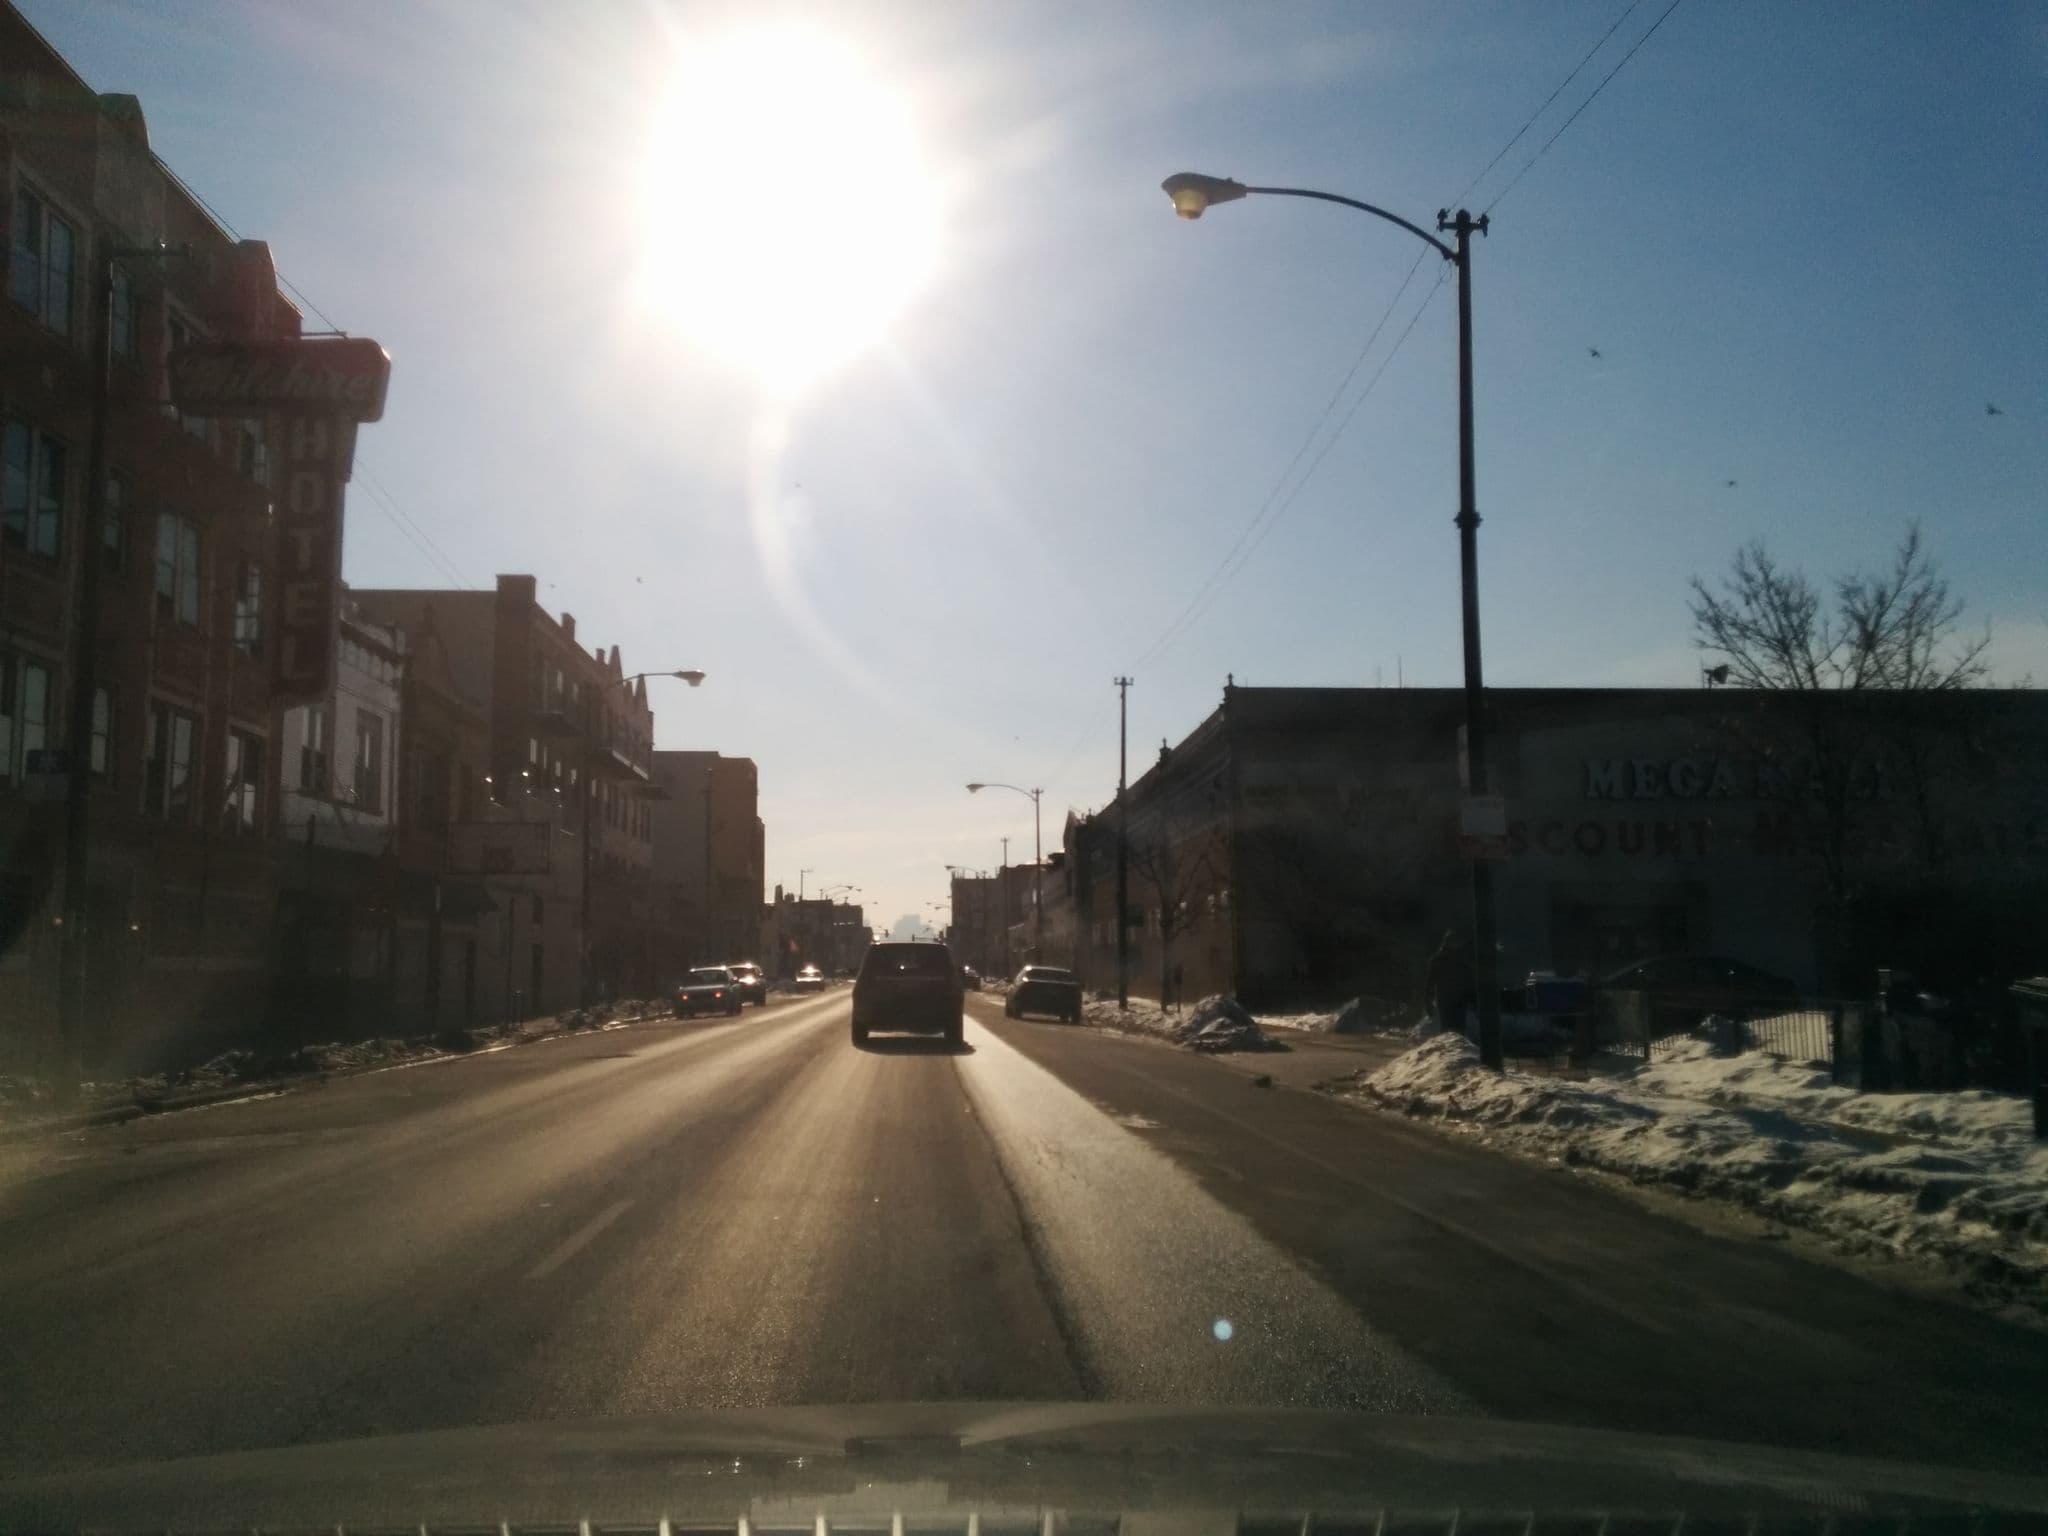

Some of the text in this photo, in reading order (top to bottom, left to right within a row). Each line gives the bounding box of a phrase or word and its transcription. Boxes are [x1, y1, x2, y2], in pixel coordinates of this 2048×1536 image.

[282, 416, 327, 679] HOTEL
[1583, 757, 1738, 799] MEGA
[1478, 819, 1707, 856] SCOUNT
